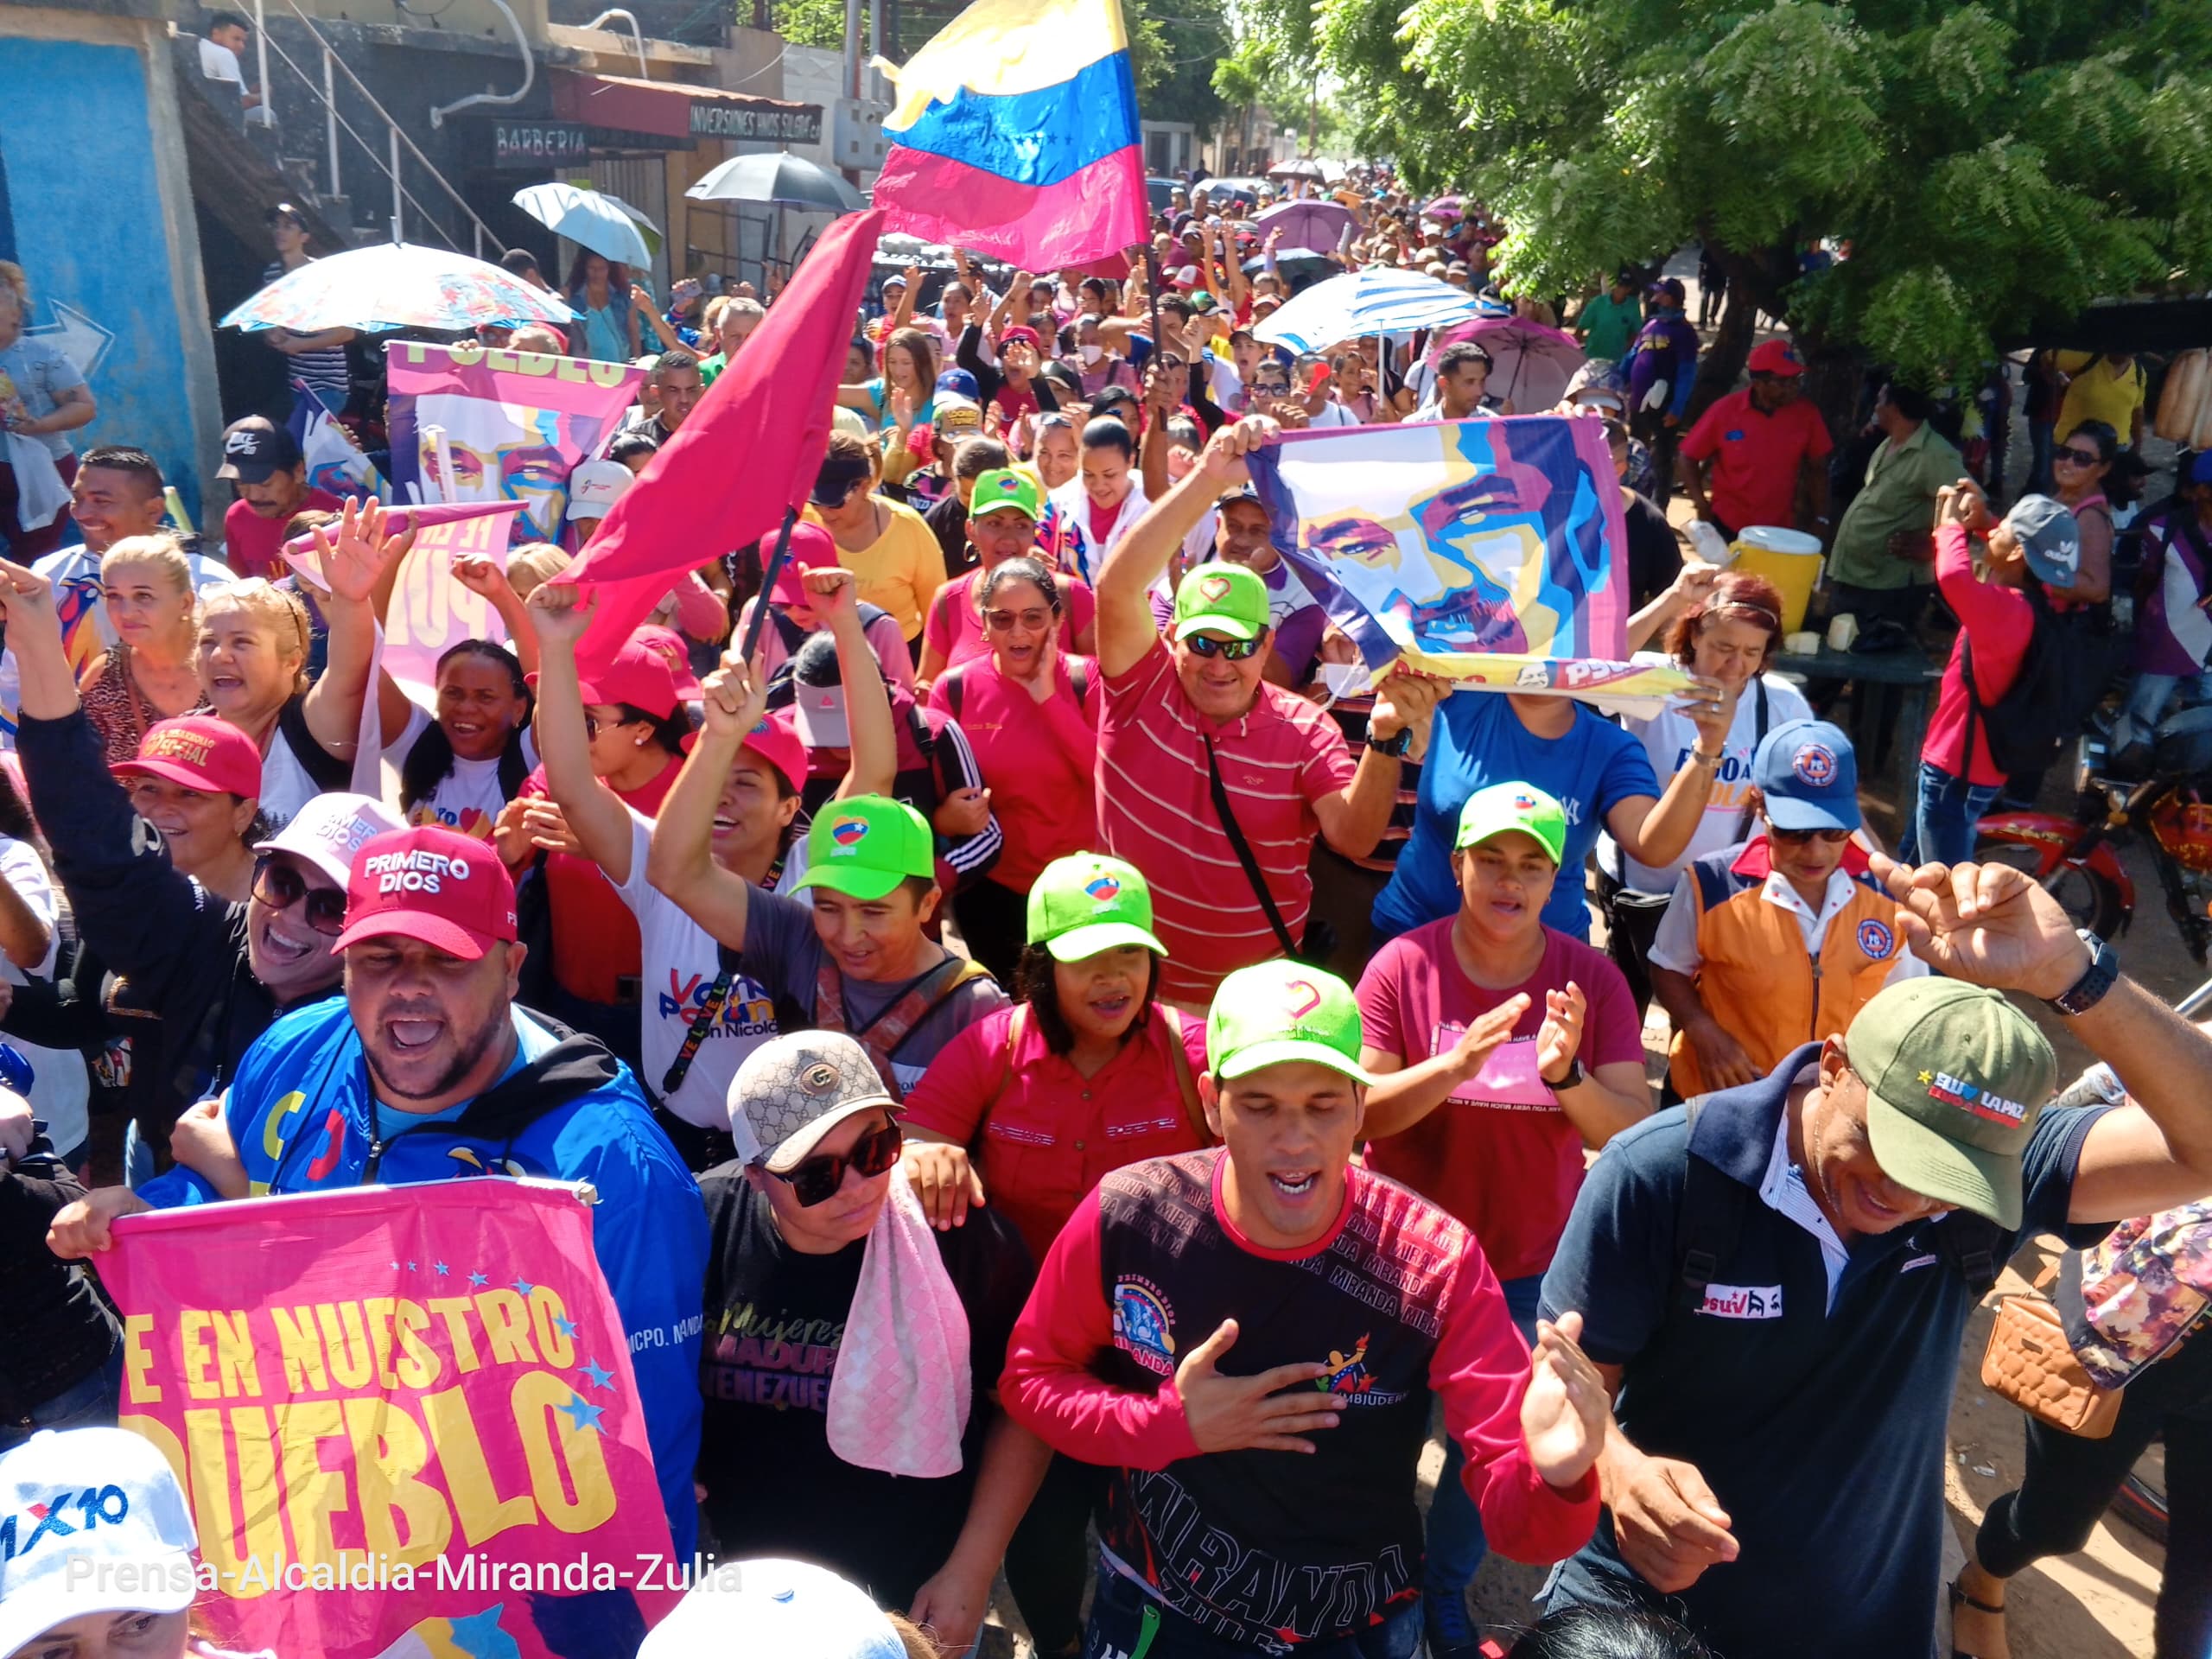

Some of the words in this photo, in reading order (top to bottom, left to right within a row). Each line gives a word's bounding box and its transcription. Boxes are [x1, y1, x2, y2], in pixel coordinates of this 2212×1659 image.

[497, 127, 587, 156] BARBERIA
[156, 739, 209, 767] SOCIAL
[316, 824, 363, 852] DIOS
[364, 849, 470, 880] PRIMERO
[378, 872, 442, 893] DIOS
[1328, 1263, 1399, 1318] MIRANDA
[1362, 1252, 1433, 1299] MIRANDA
[180, 1309, 262, 1400] EN
[270, 1285, 575, 1394] NUESTRO
[1113, 1335, 1176, 1376] MIANDA
